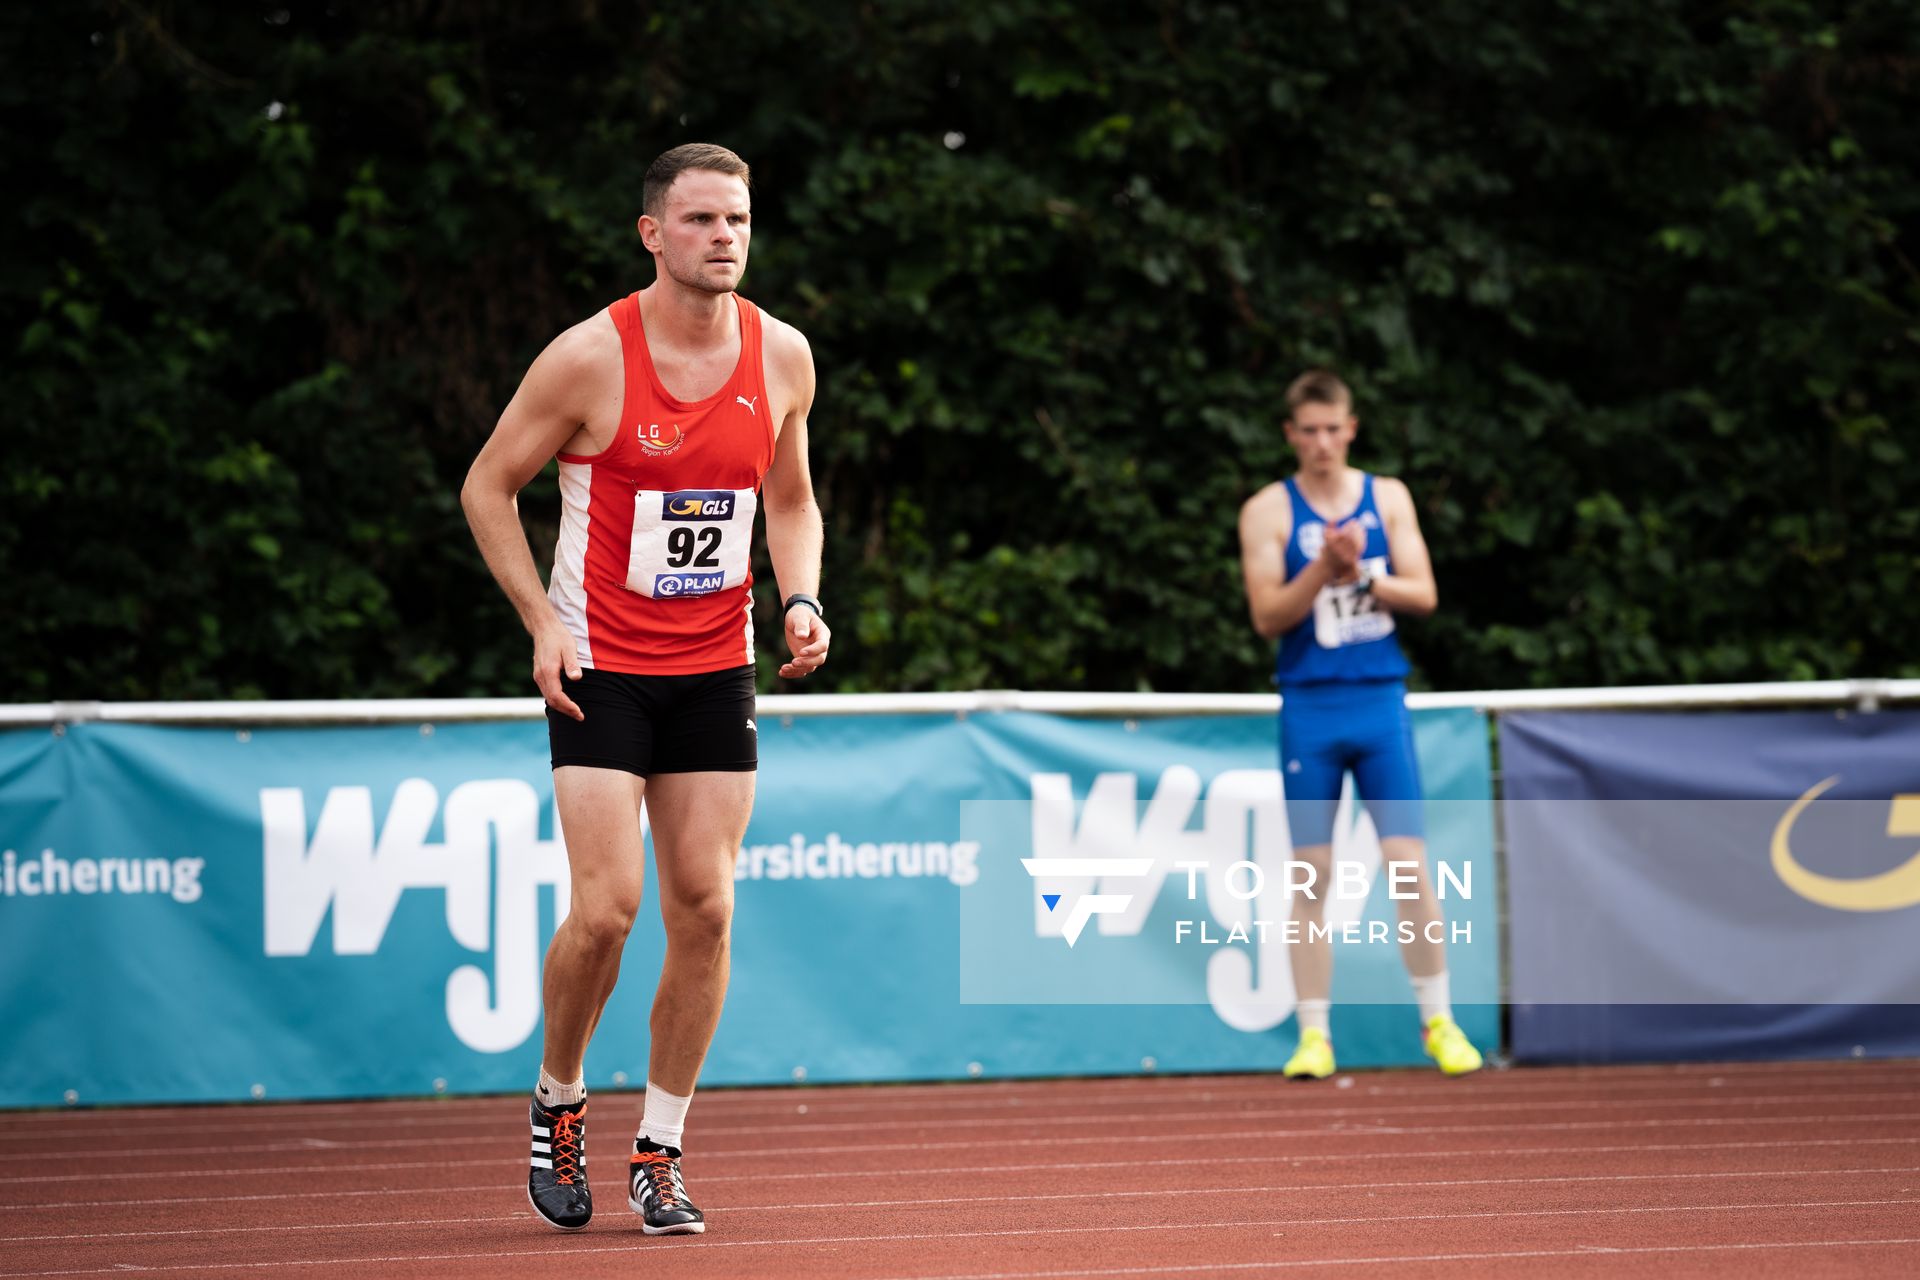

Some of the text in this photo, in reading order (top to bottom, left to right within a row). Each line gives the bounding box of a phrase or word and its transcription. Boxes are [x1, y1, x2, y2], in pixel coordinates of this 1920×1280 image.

[637, 423, 659, 438] LG
[640, 445, 661, 457] Region
[701, 499, 730, 515] GLS
[666, 526, 723, 568] 92
[684, 576, 722, 590] PLAN
[0, 847, 205, 904] icherung
